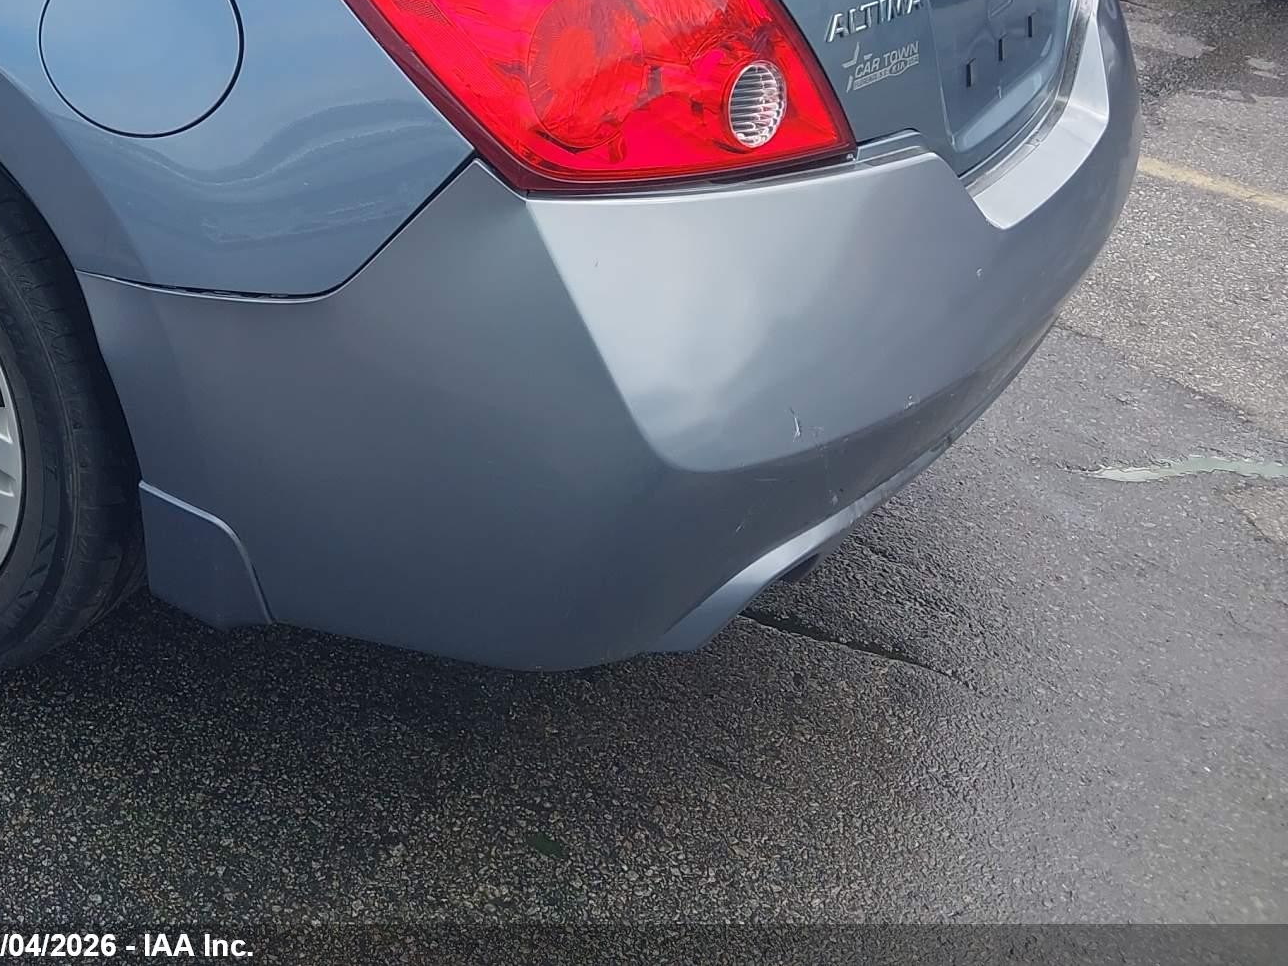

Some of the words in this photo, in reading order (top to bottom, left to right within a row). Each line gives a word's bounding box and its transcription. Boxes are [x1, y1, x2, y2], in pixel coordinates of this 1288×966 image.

[855, 56, 880, 78] CAR
[883, 40, 920, 66] TOWN
[891, 61, 907, 74] KIA
